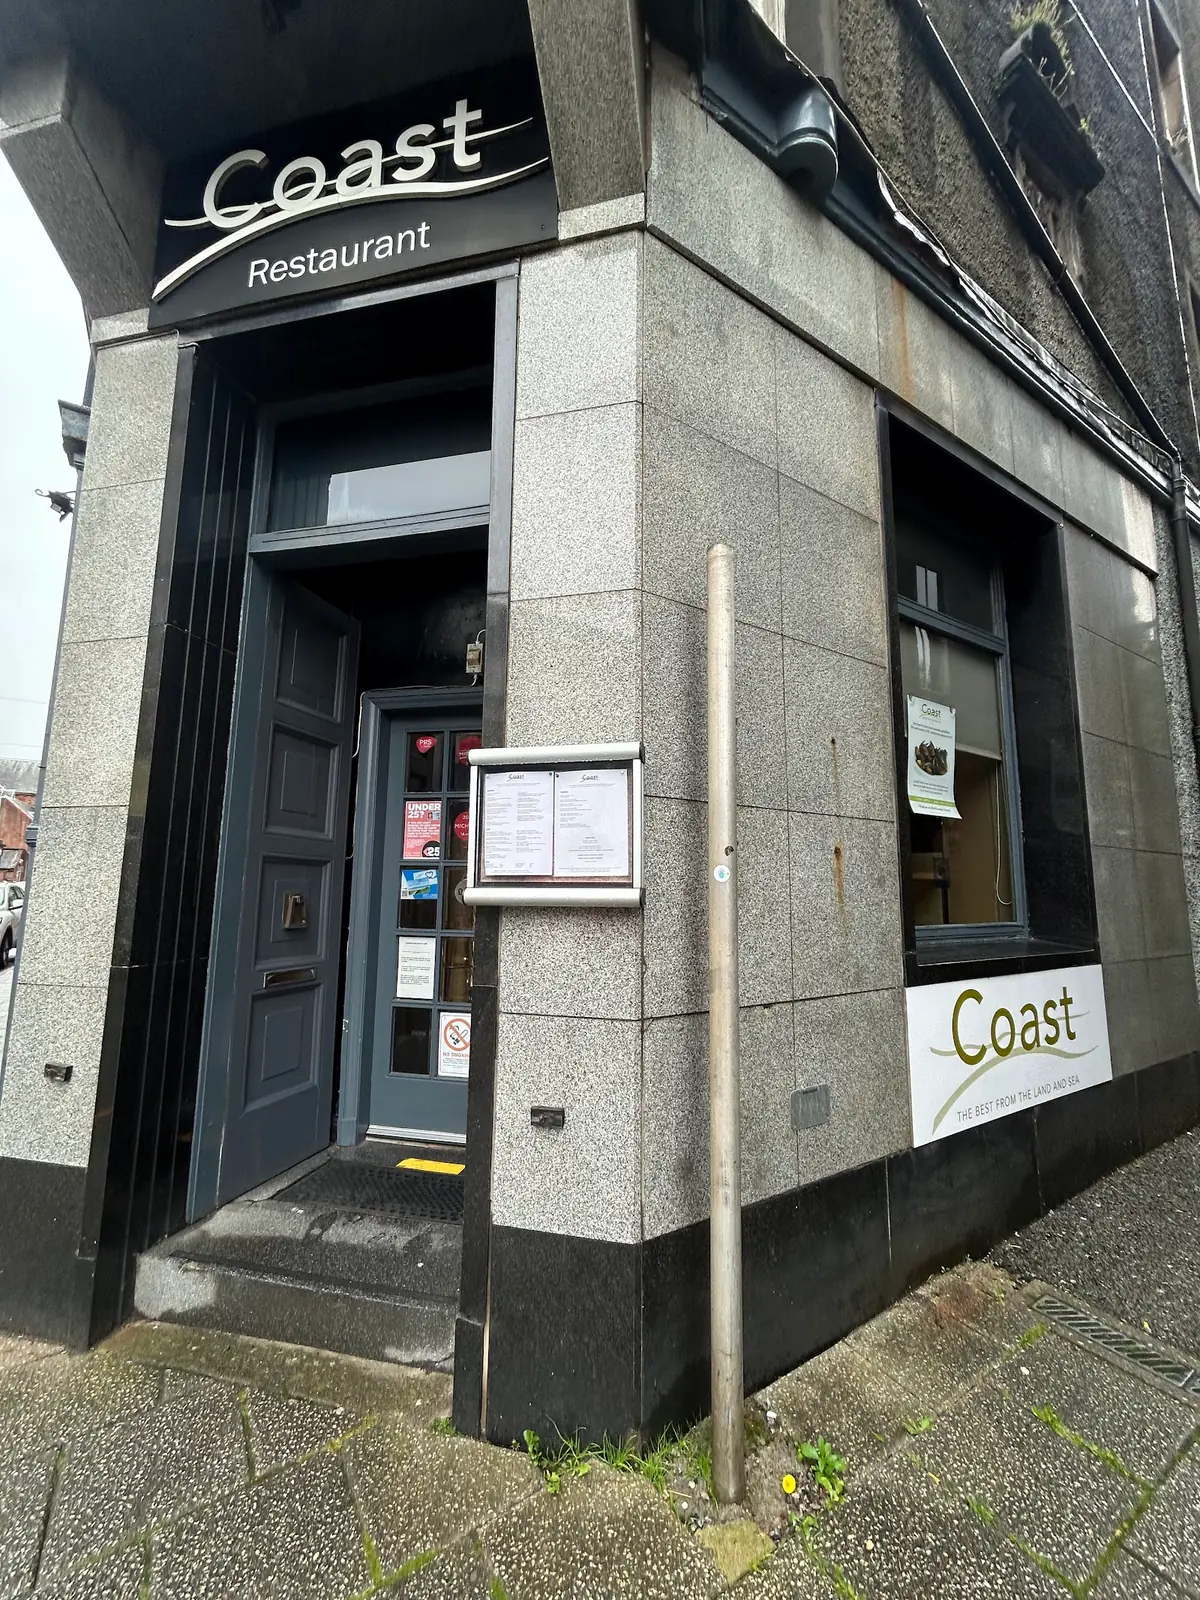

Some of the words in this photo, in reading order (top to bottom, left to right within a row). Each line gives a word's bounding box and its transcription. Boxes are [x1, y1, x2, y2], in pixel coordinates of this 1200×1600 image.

[203, 98, 483, 230] Coast
[247, 221, 431, 288] Restaurant
[921, 703, 941, 718] Coast
[407, 803, 441, 811] UNDER
[407, 811, 425, 819] 25?
[952, 986, 1077, 1066] Coast
[956, 1108, 973, 1123] THE
[975, 1101, 994, 1117] BEST
[995, 1094, 1017, 1111] FROM
[1018, 1088, 1032, 1102] THE
[1034, 1083, 1051, 1099] LAND
[1052, 1078, 1067, 1092] AND
[1068, 1074, 1080, 1087] SEA
